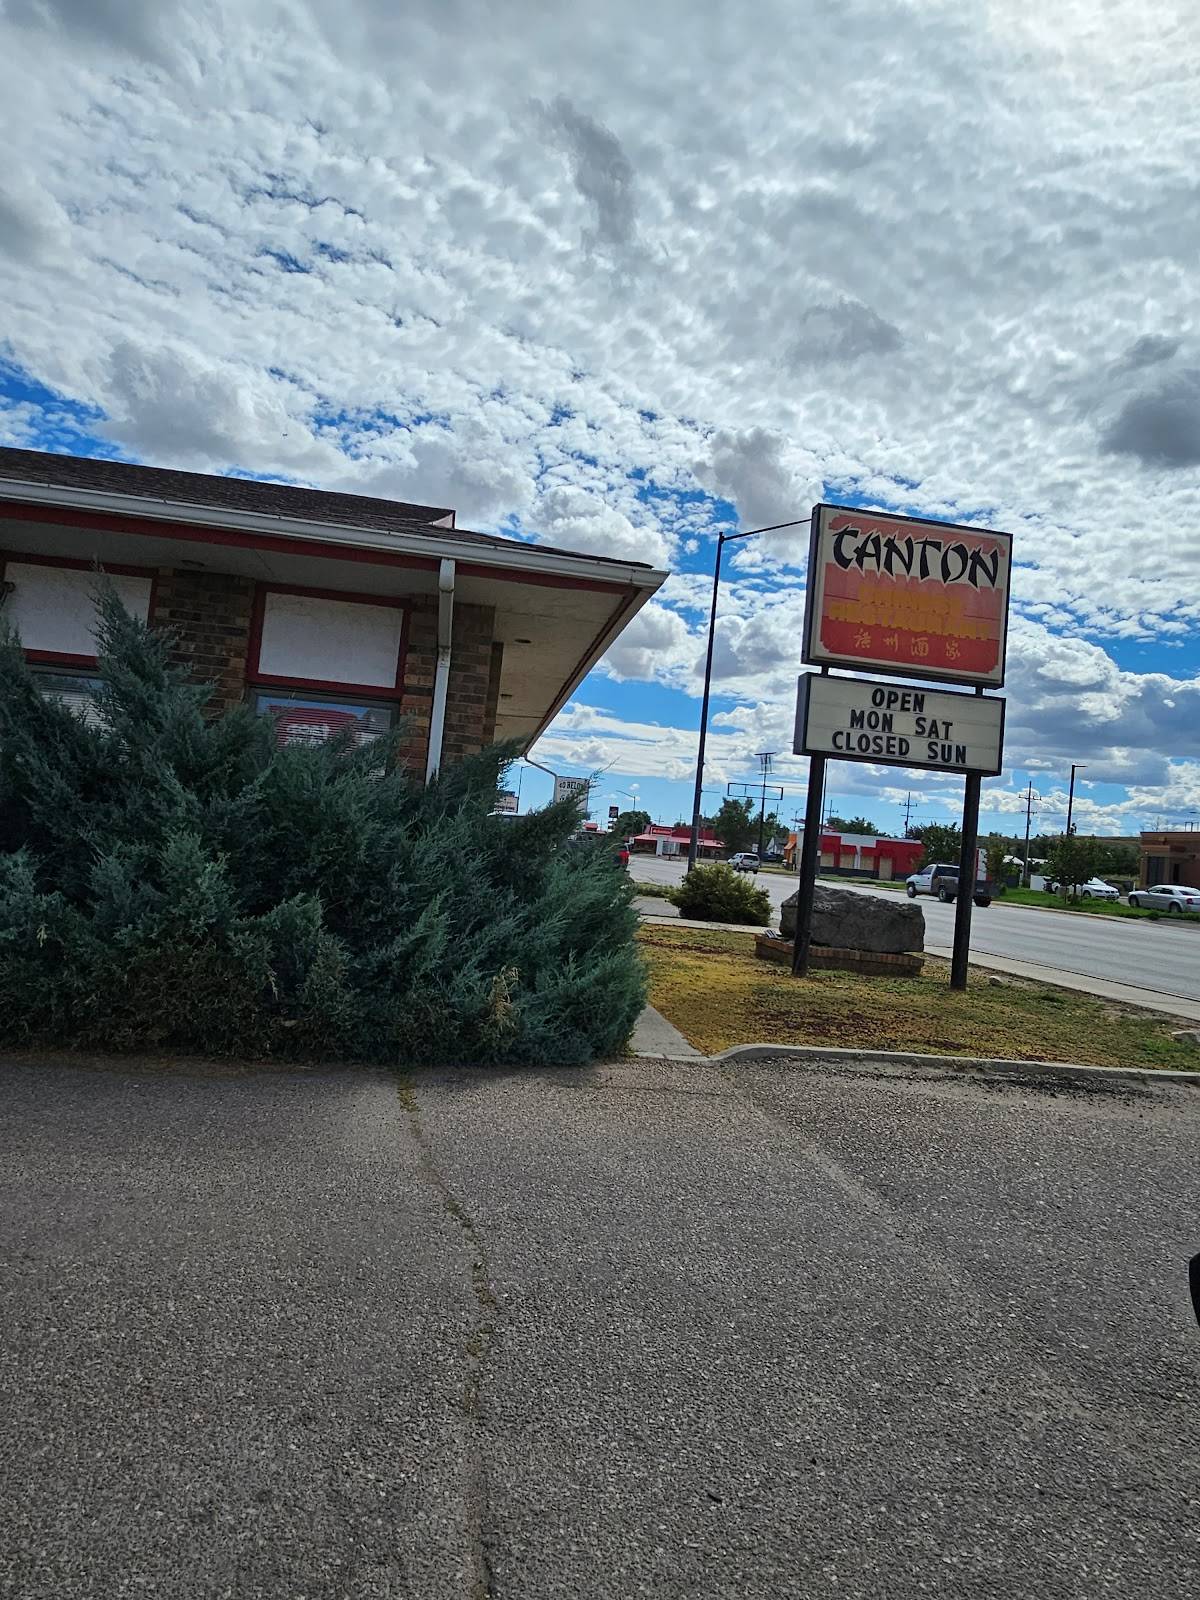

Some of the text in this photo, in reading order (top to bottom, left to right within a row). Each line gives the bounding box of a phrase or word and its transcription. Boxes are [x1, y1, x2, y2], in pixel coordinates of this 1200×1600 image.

[833, 526, 998, 588] CANTON
[872, 688, 925, 713] OPEN
[851, 709, 953, 740] MON SAT
[832, 731, 967, 764] CLOSED SUN
